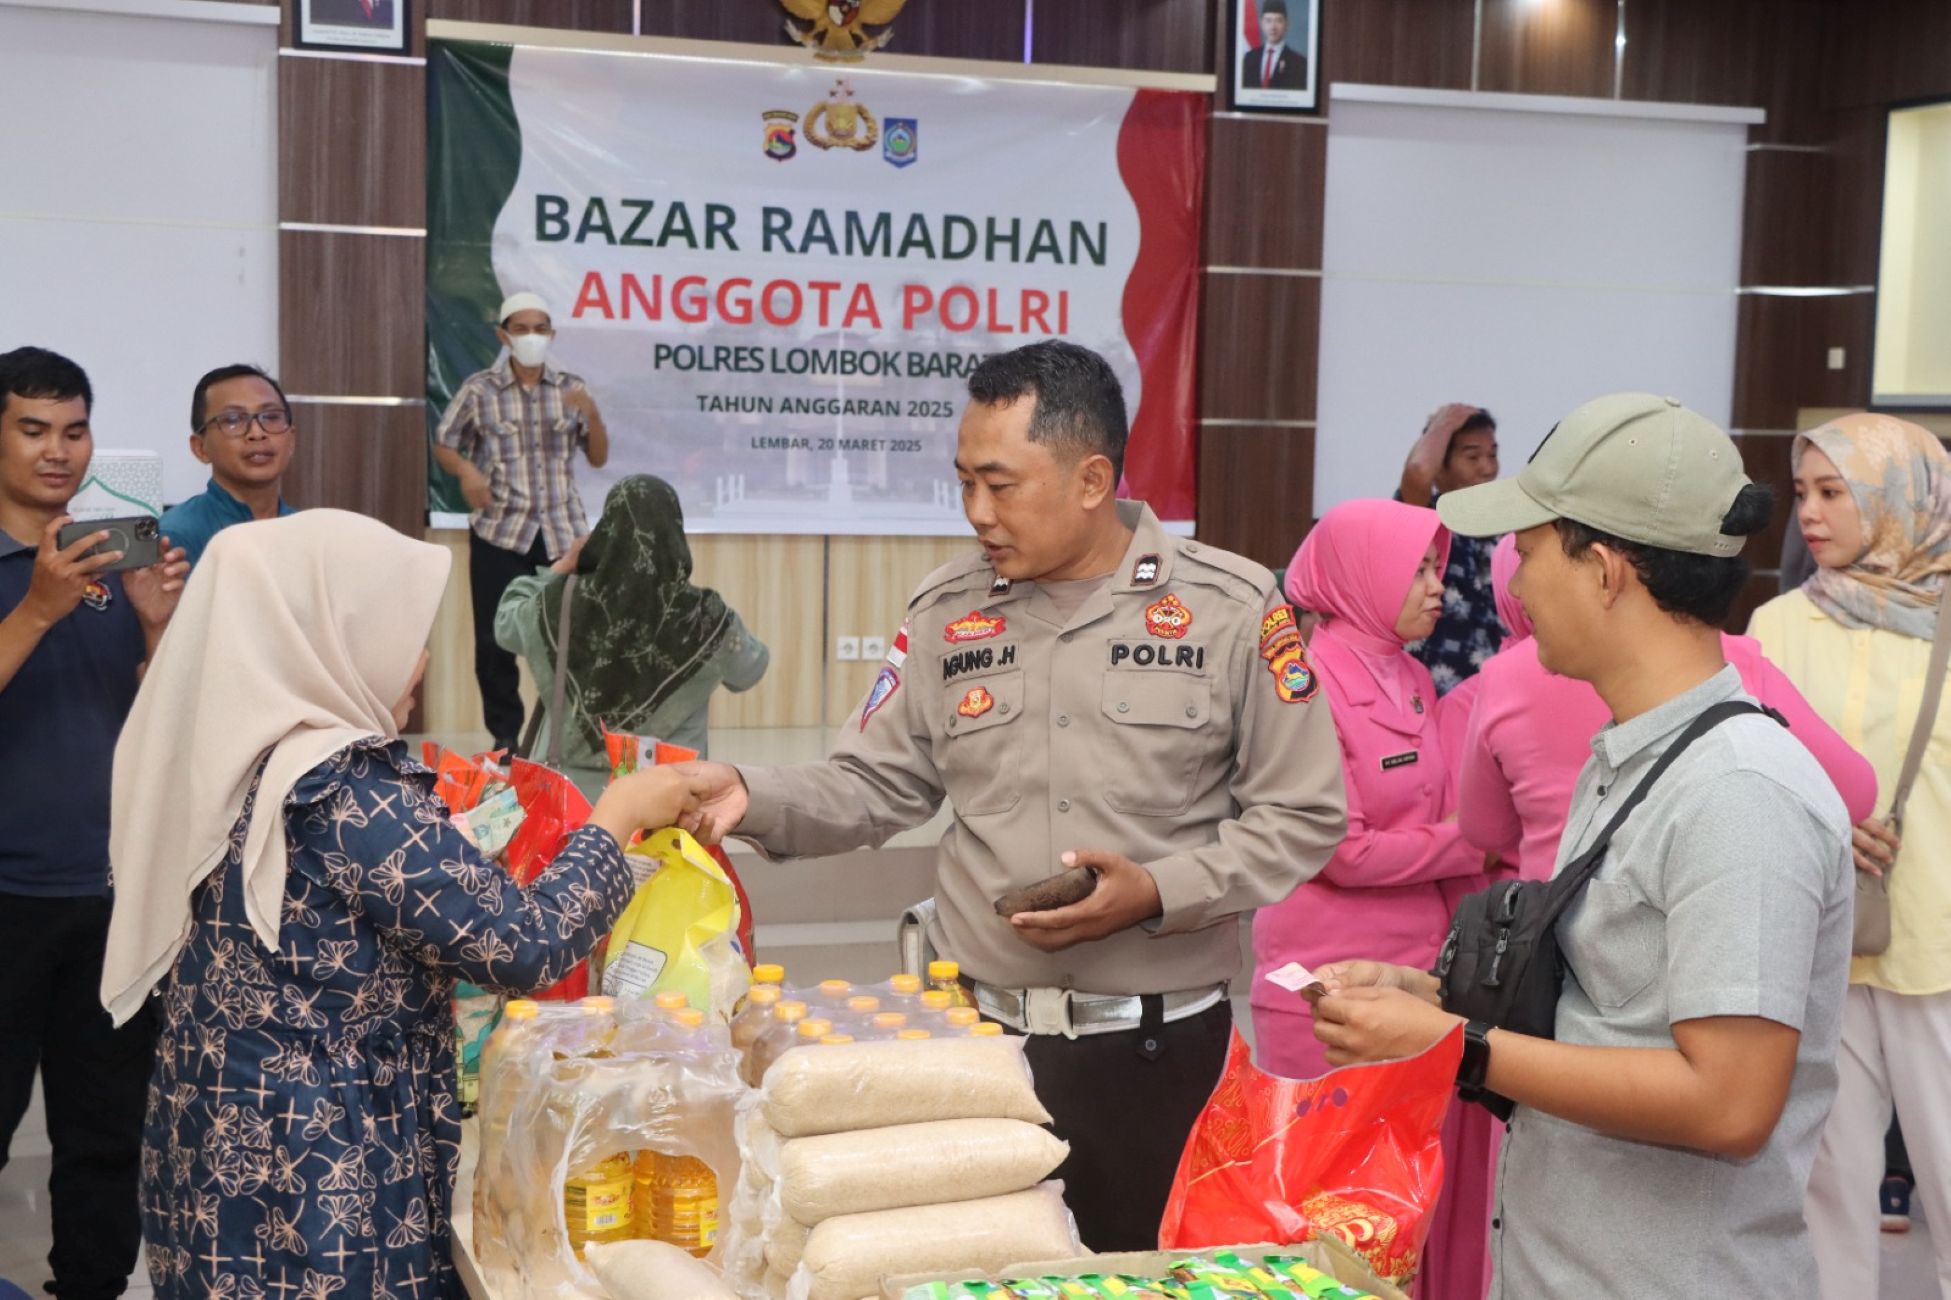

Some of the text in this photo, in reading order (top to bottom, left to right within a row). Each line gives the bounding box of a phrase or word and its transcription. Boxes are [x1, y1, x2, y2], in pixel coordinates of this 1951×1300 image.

[535, 194, 1108, 267] BAZAR RAMADHAN
[571, 270, 1070, 336] ANGGOTA POLRI
[653, 343, 765, 374] POLRES
[771, 347, 902, 376] LOMBOK
[696, 394, 954, 418] TAHUN ANGGARAN 2025
[751, 435, 923, 453] LEMBAR, 20 MARET 2025
[943, 648, 993, 680] AGUNG
[1111, 643, 1205, 670] POLRI
